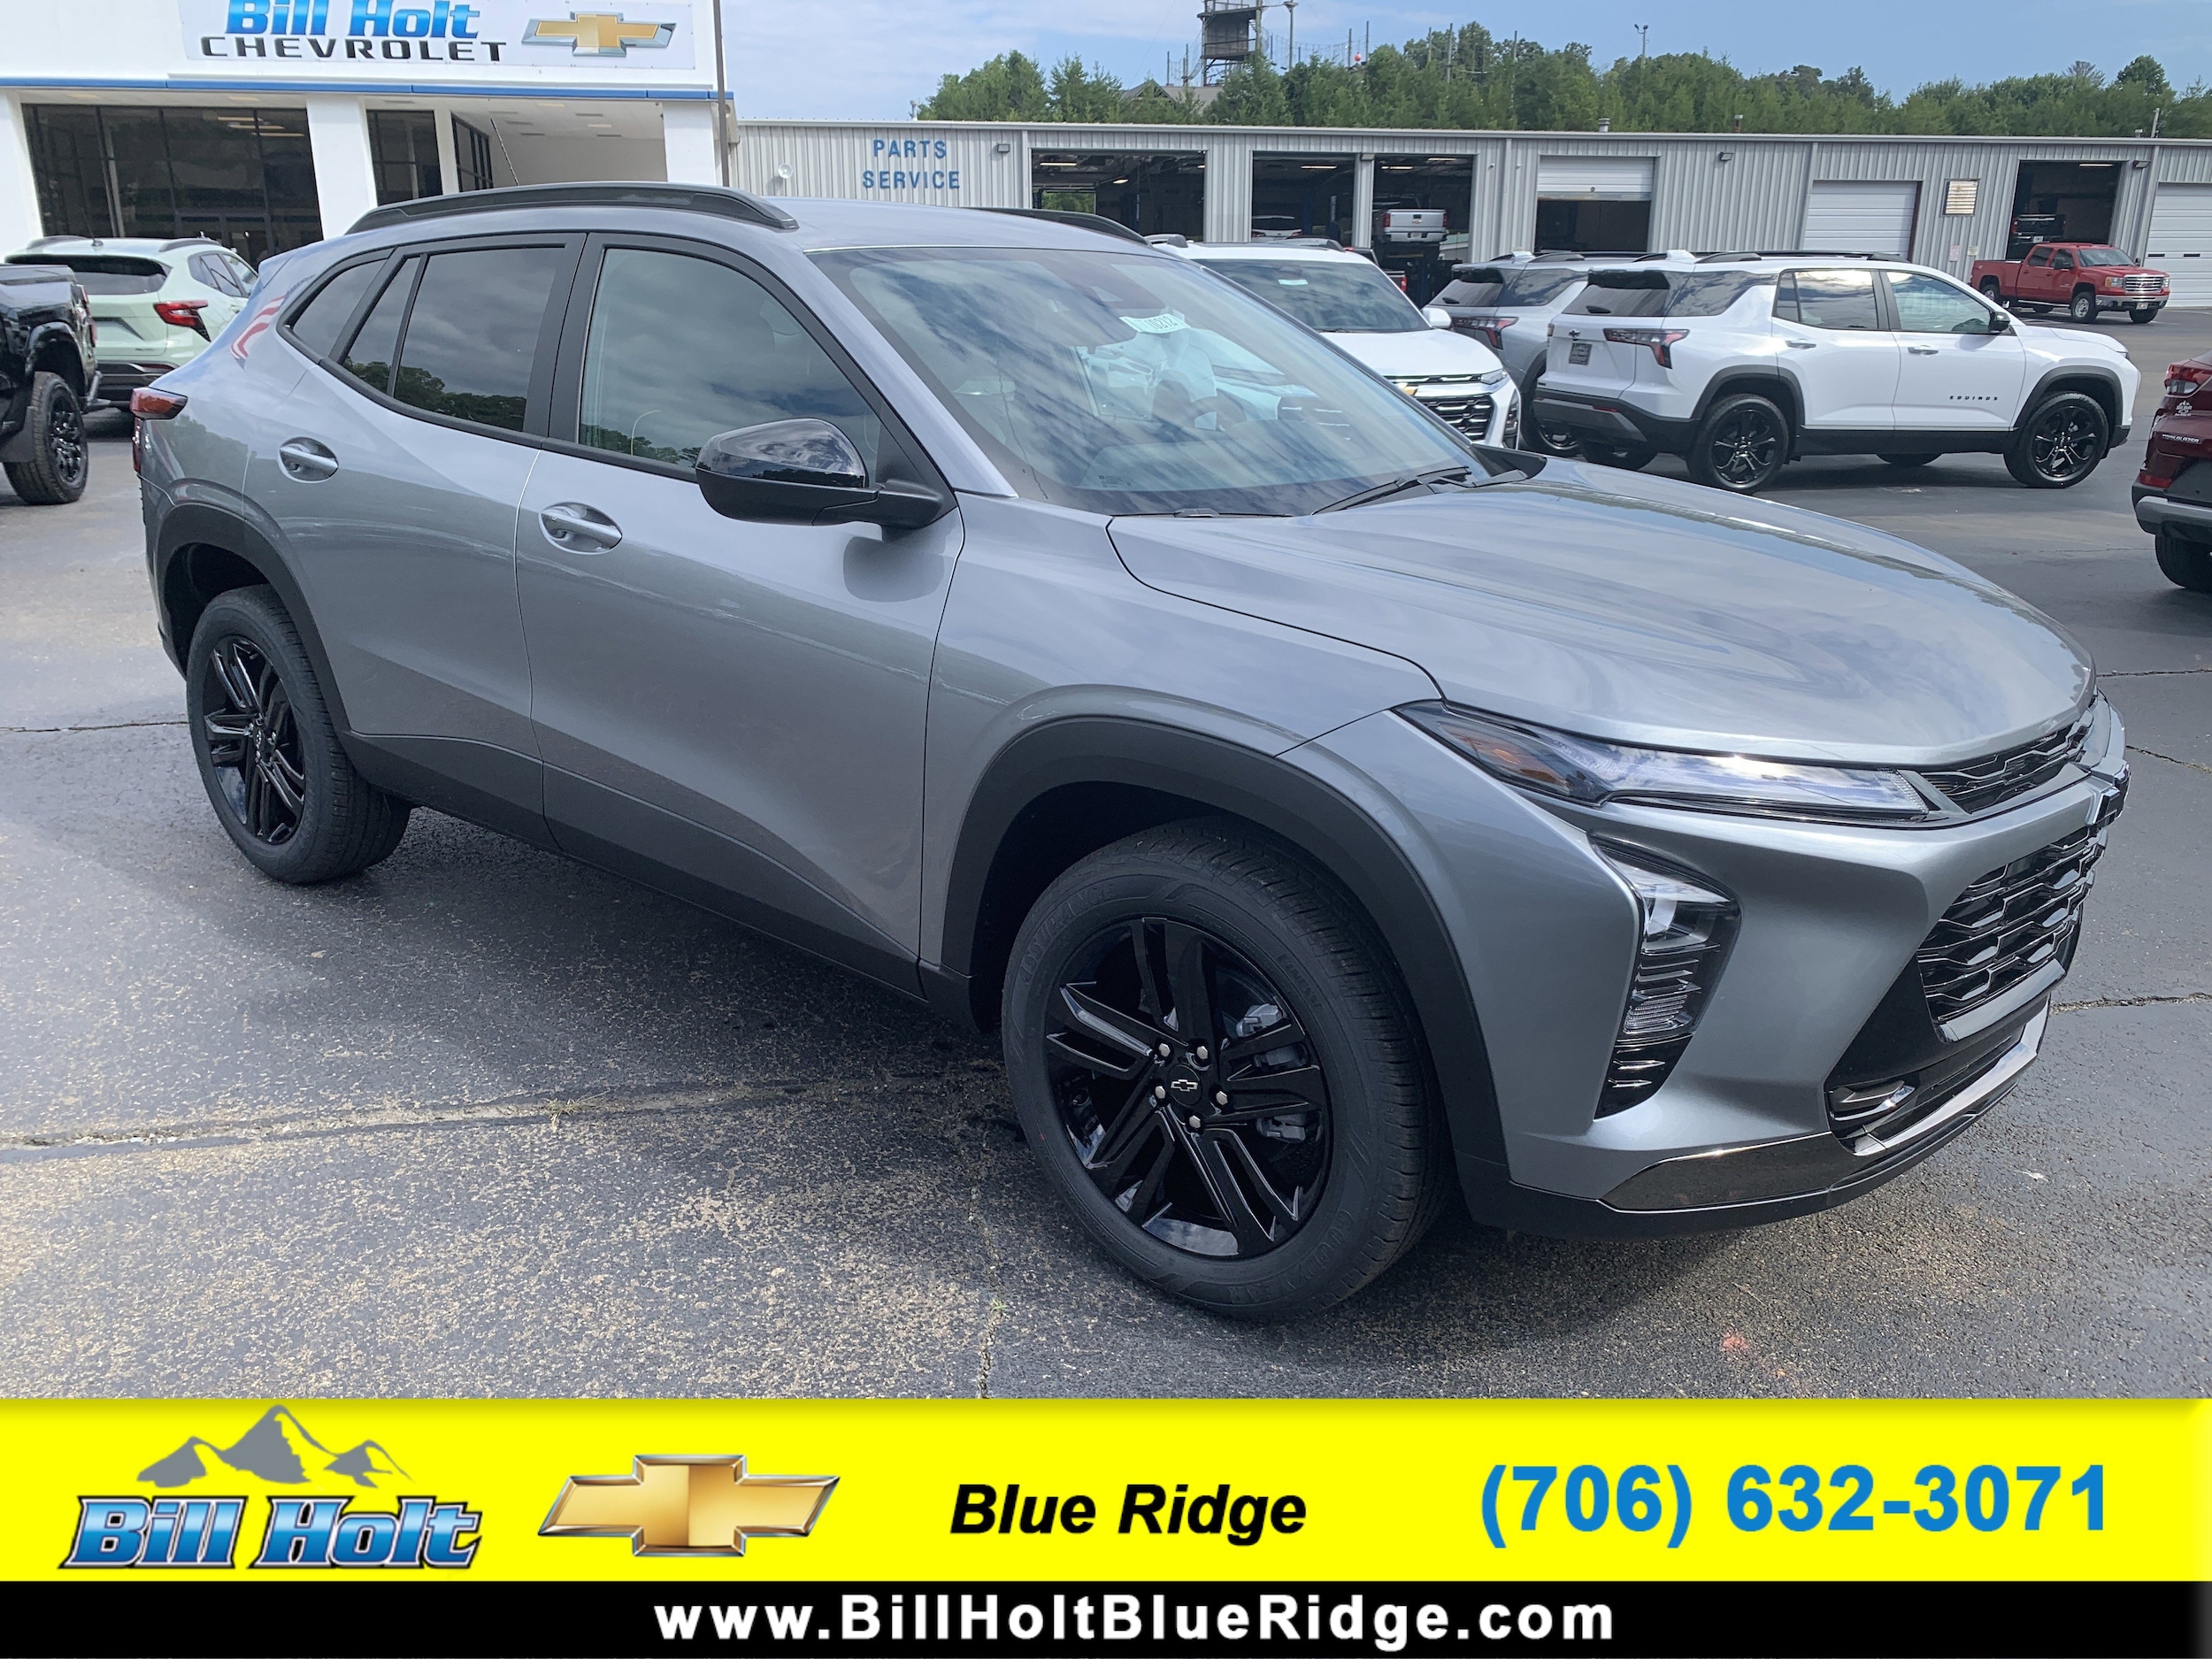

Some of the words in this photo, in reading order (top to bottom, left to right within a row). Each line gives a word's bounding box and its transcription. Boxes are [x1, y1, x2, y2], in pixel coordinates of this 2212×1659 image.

[225, 0, 331, 36] Bill
[347, 0, 481, 39] Holt
[200, 35, 507, 62] CHEVROLET
[872, 139, 948, 159] PARTS
[862, 170, 961, 189] SERVICE
